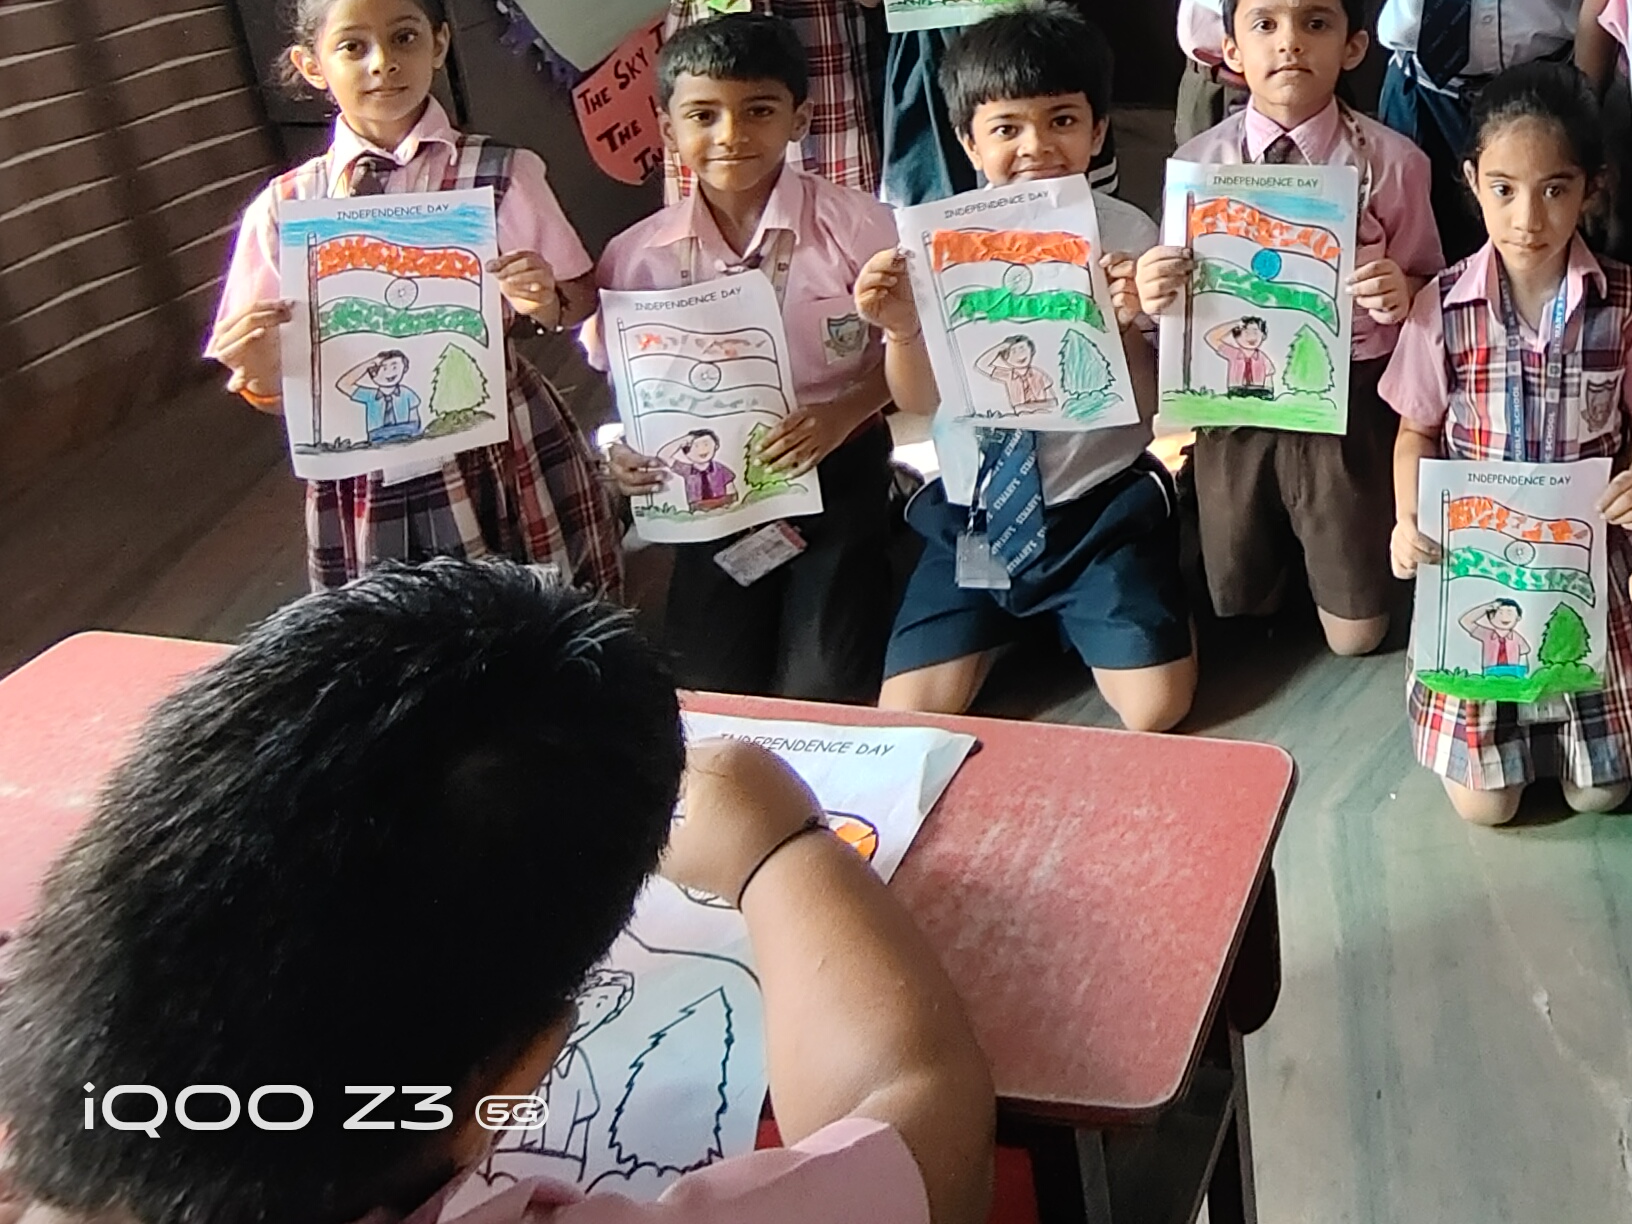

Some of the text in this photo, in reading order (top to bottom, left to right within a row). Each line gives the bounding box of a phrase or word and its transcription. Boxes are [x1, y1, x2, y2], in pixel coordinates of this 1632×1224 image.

[577, 87, 612, 115] THE
[613, 47, 648, 90] SKY
[596, 120, 642, 152] THE
[1213, 176, 1319, 188] INDEPENDENCE DAY
[337, 204, 449, 220] INDEPENDENCE DAY
[944, 190, 1049, 219] INDEPENDENCE DAY
[634, 286, 742, 311] INDEPENDENCE DAY
[1513, 385, 1521, 426] SCHOOL
[1545, 411, 1556, 452] SCHOOL
[1467, 473, 1571, 486] INDEPENDENCE DAY
[721, 733, 895, 756] DEPENDENCE DAY
